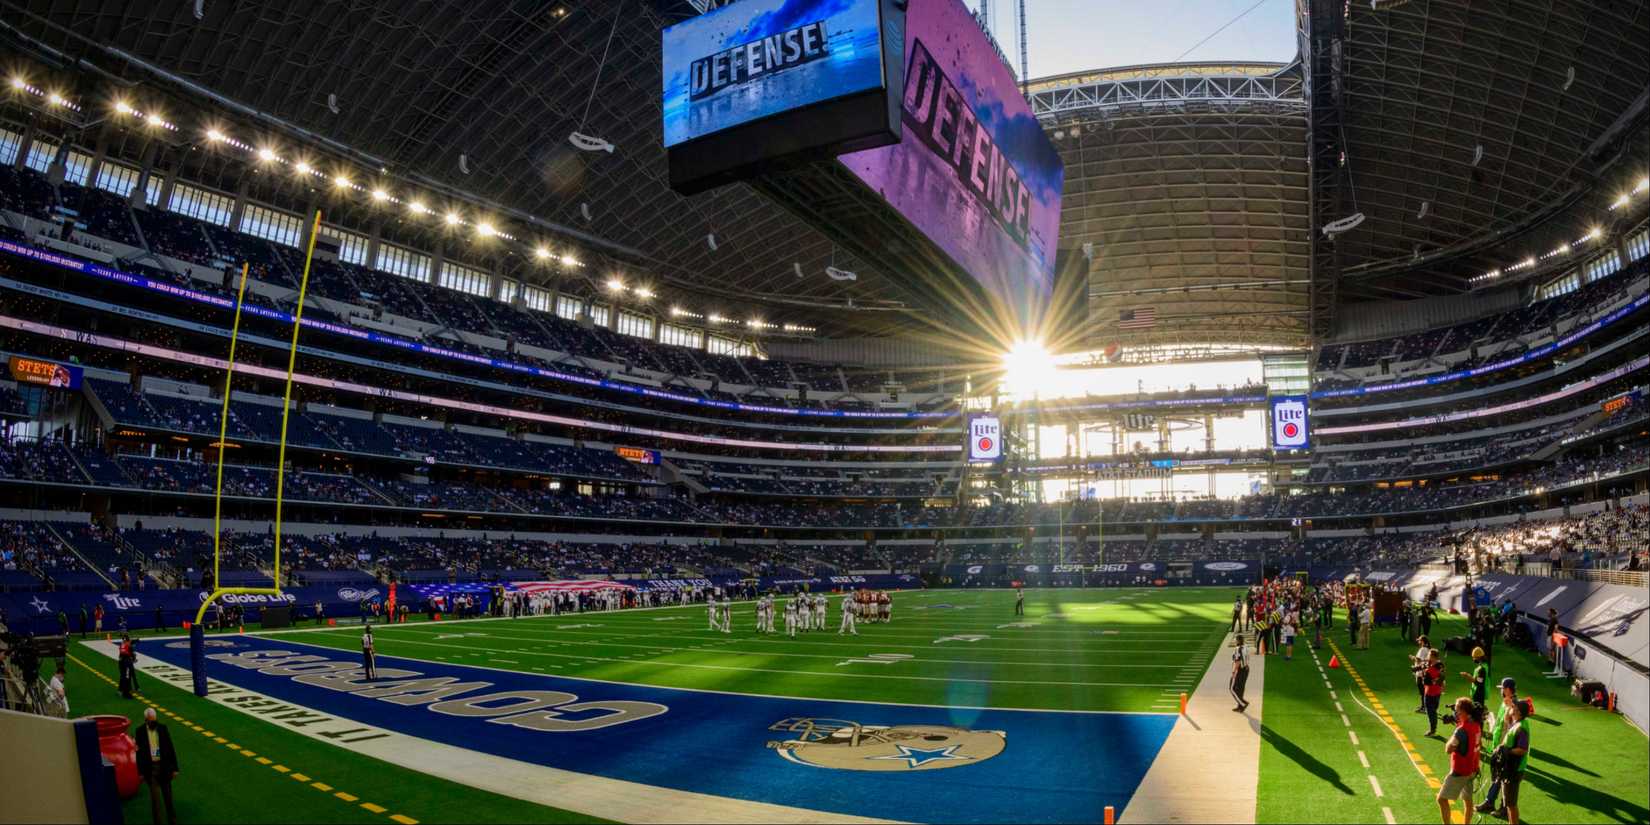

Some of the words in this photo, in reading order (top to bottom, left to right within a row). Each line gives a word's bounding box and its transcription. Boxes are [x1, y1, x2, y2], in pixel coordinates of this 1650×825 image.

[691, 21, 829, 97] DEFENSE!
[904, 43, 1032, 246] DEFENSE!
[1279, 410, 1302, 422] Lite
[975, 424, 998, 437] Lite
[1093, 563, 1128, 573] 1960
[111, 593, 140, 610] Lite
[222, 594, 267, 604] Globe
[204, 650, 669, 732] COWBOYS
[222, 695, 333, 728] TAKES
[316, 728, 391, 744] IT
